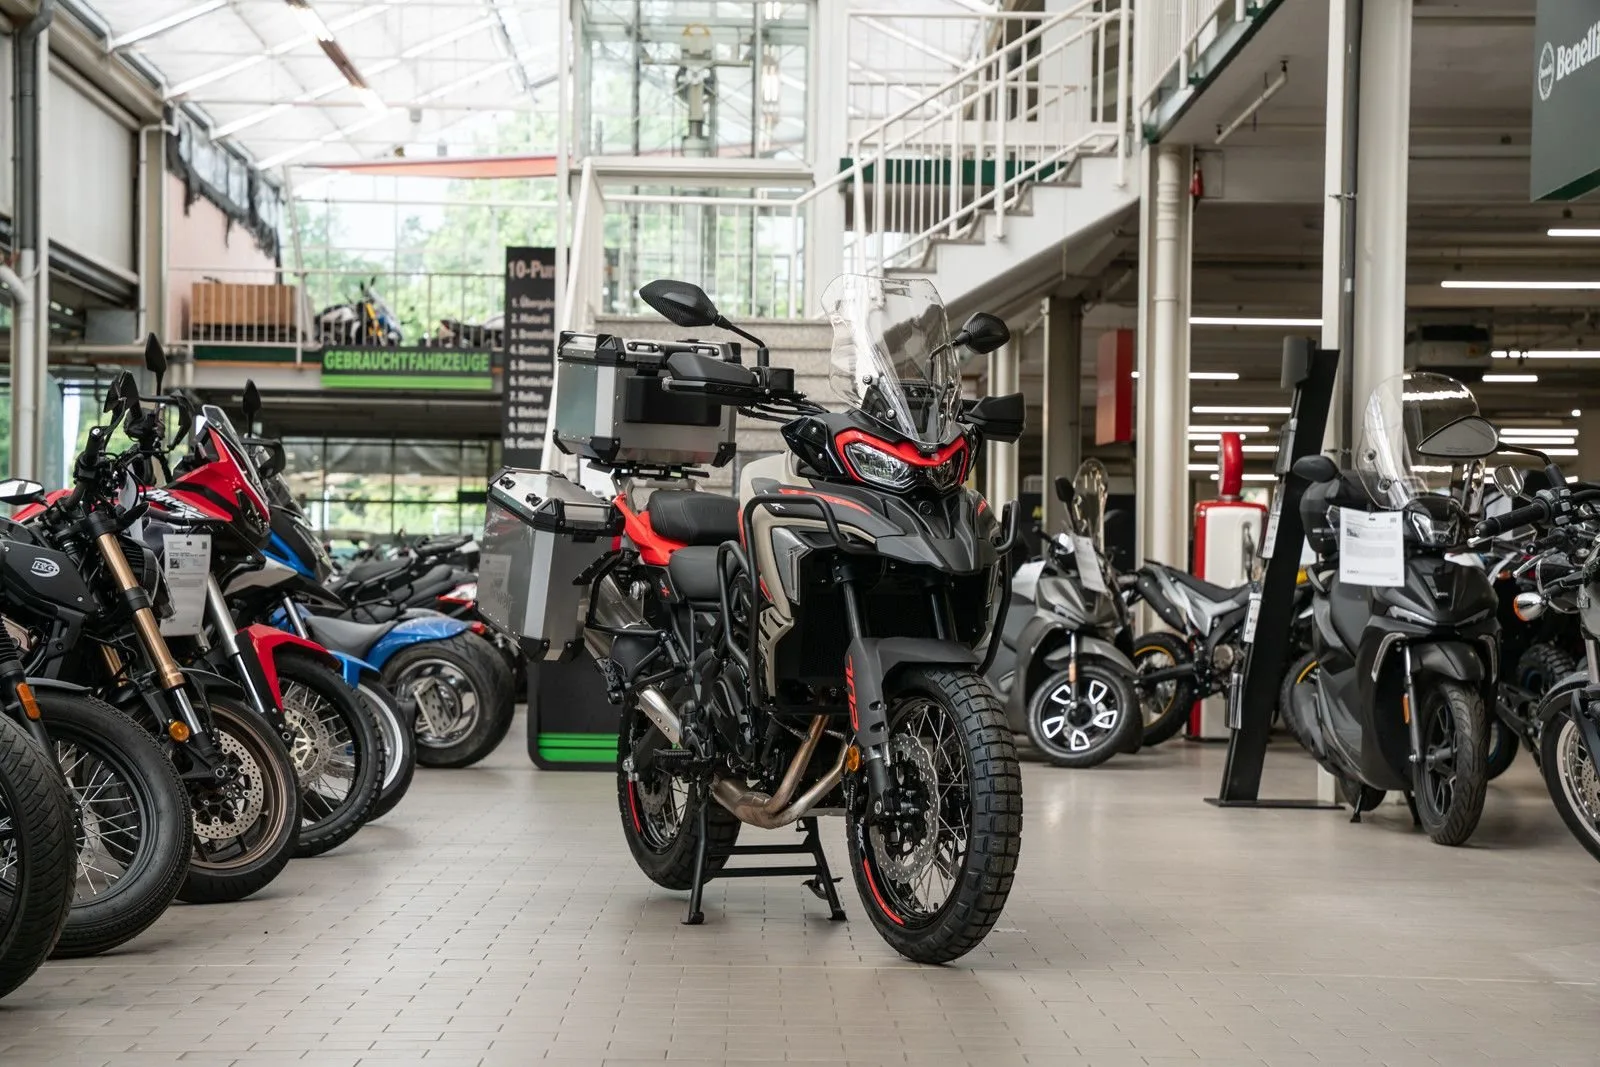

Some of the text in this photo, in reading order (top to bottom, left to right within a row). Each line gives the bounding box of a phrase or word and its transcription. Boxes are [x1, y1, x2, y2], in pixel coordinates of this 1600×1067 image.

[1556, 20, 1600, 81] Benelli
[508, 259, 555, 279] 10-Pun
[324, 350, 489, 371] GEBRAUCHTFAHRZEUGE
